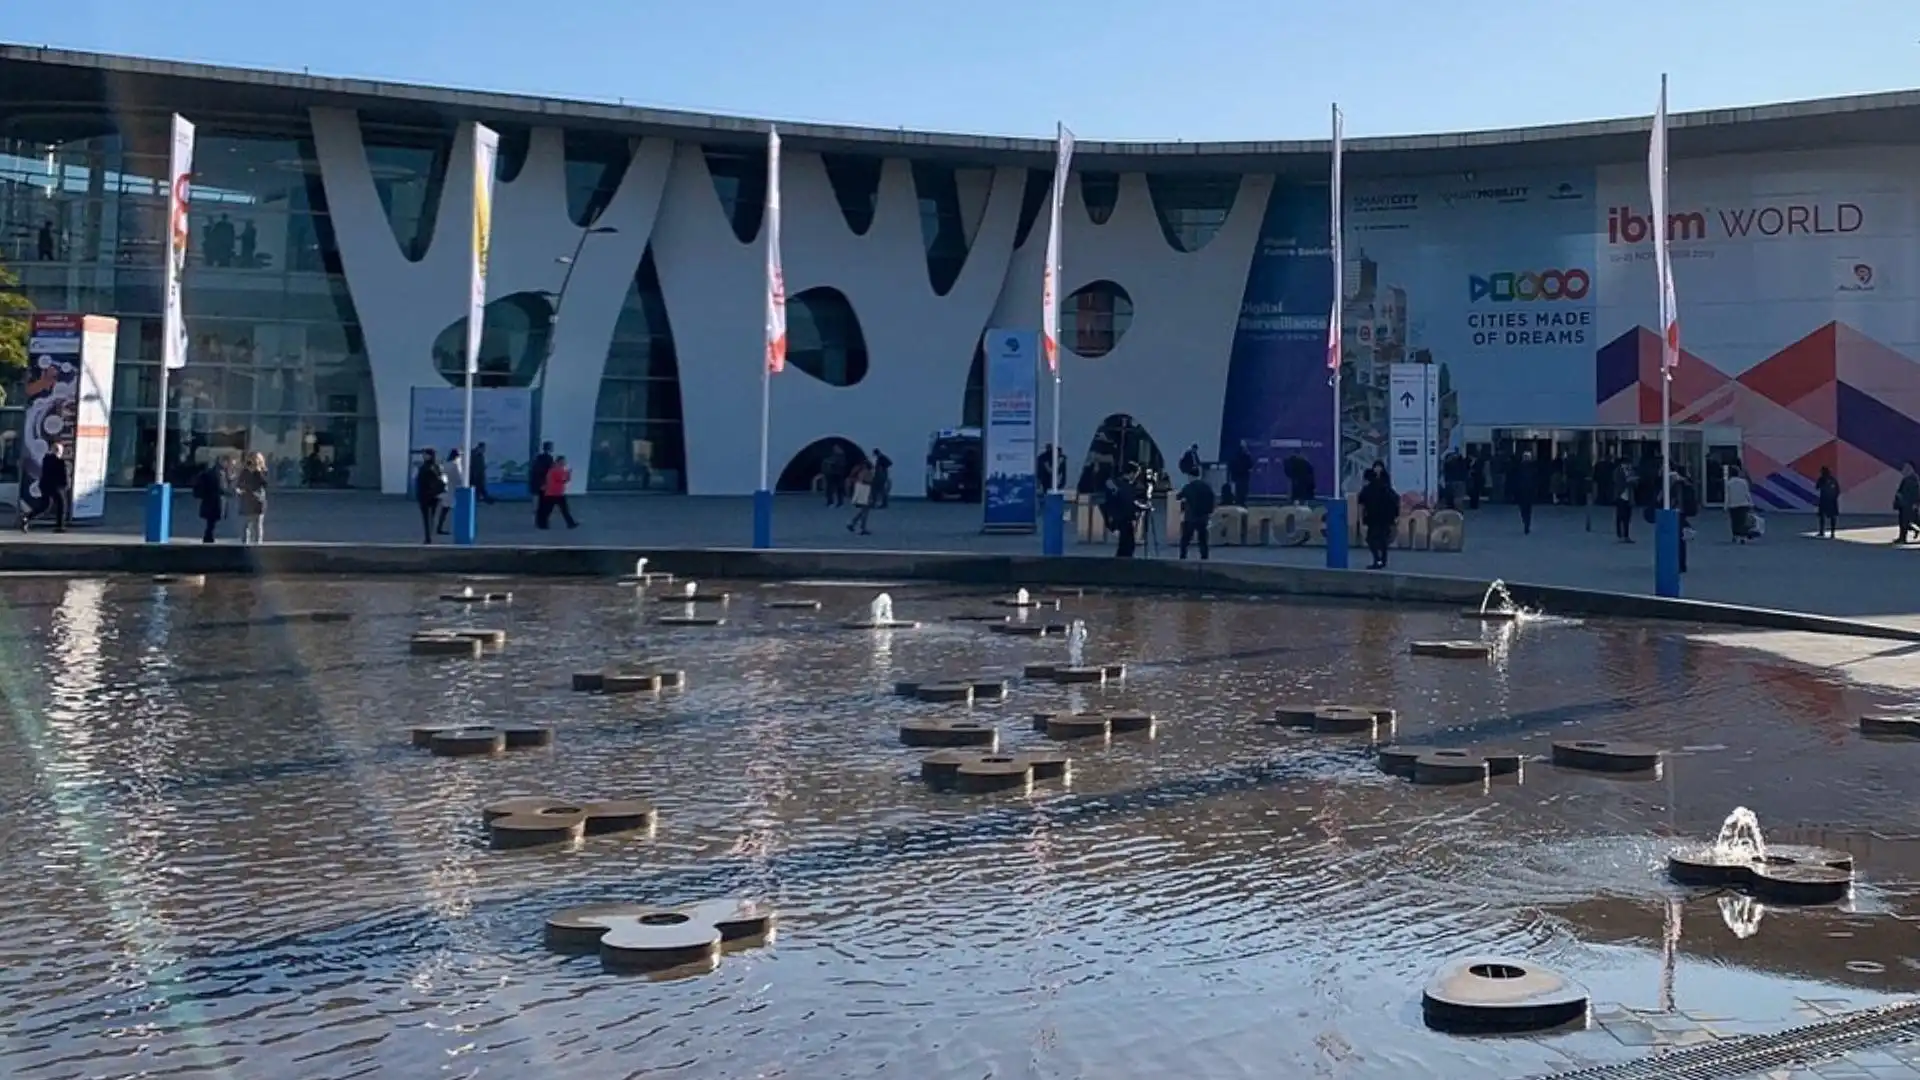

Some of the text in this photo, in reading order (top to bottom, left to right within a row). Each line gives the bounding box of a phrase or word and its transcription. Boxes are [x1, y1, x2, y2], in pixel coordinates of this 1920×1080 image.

[1718, 203, 1864, 238] WORLD
[1467, 311, 1591, 328] CITIES MADE
[1473, 329, 1585, 345] OF DREAMS
